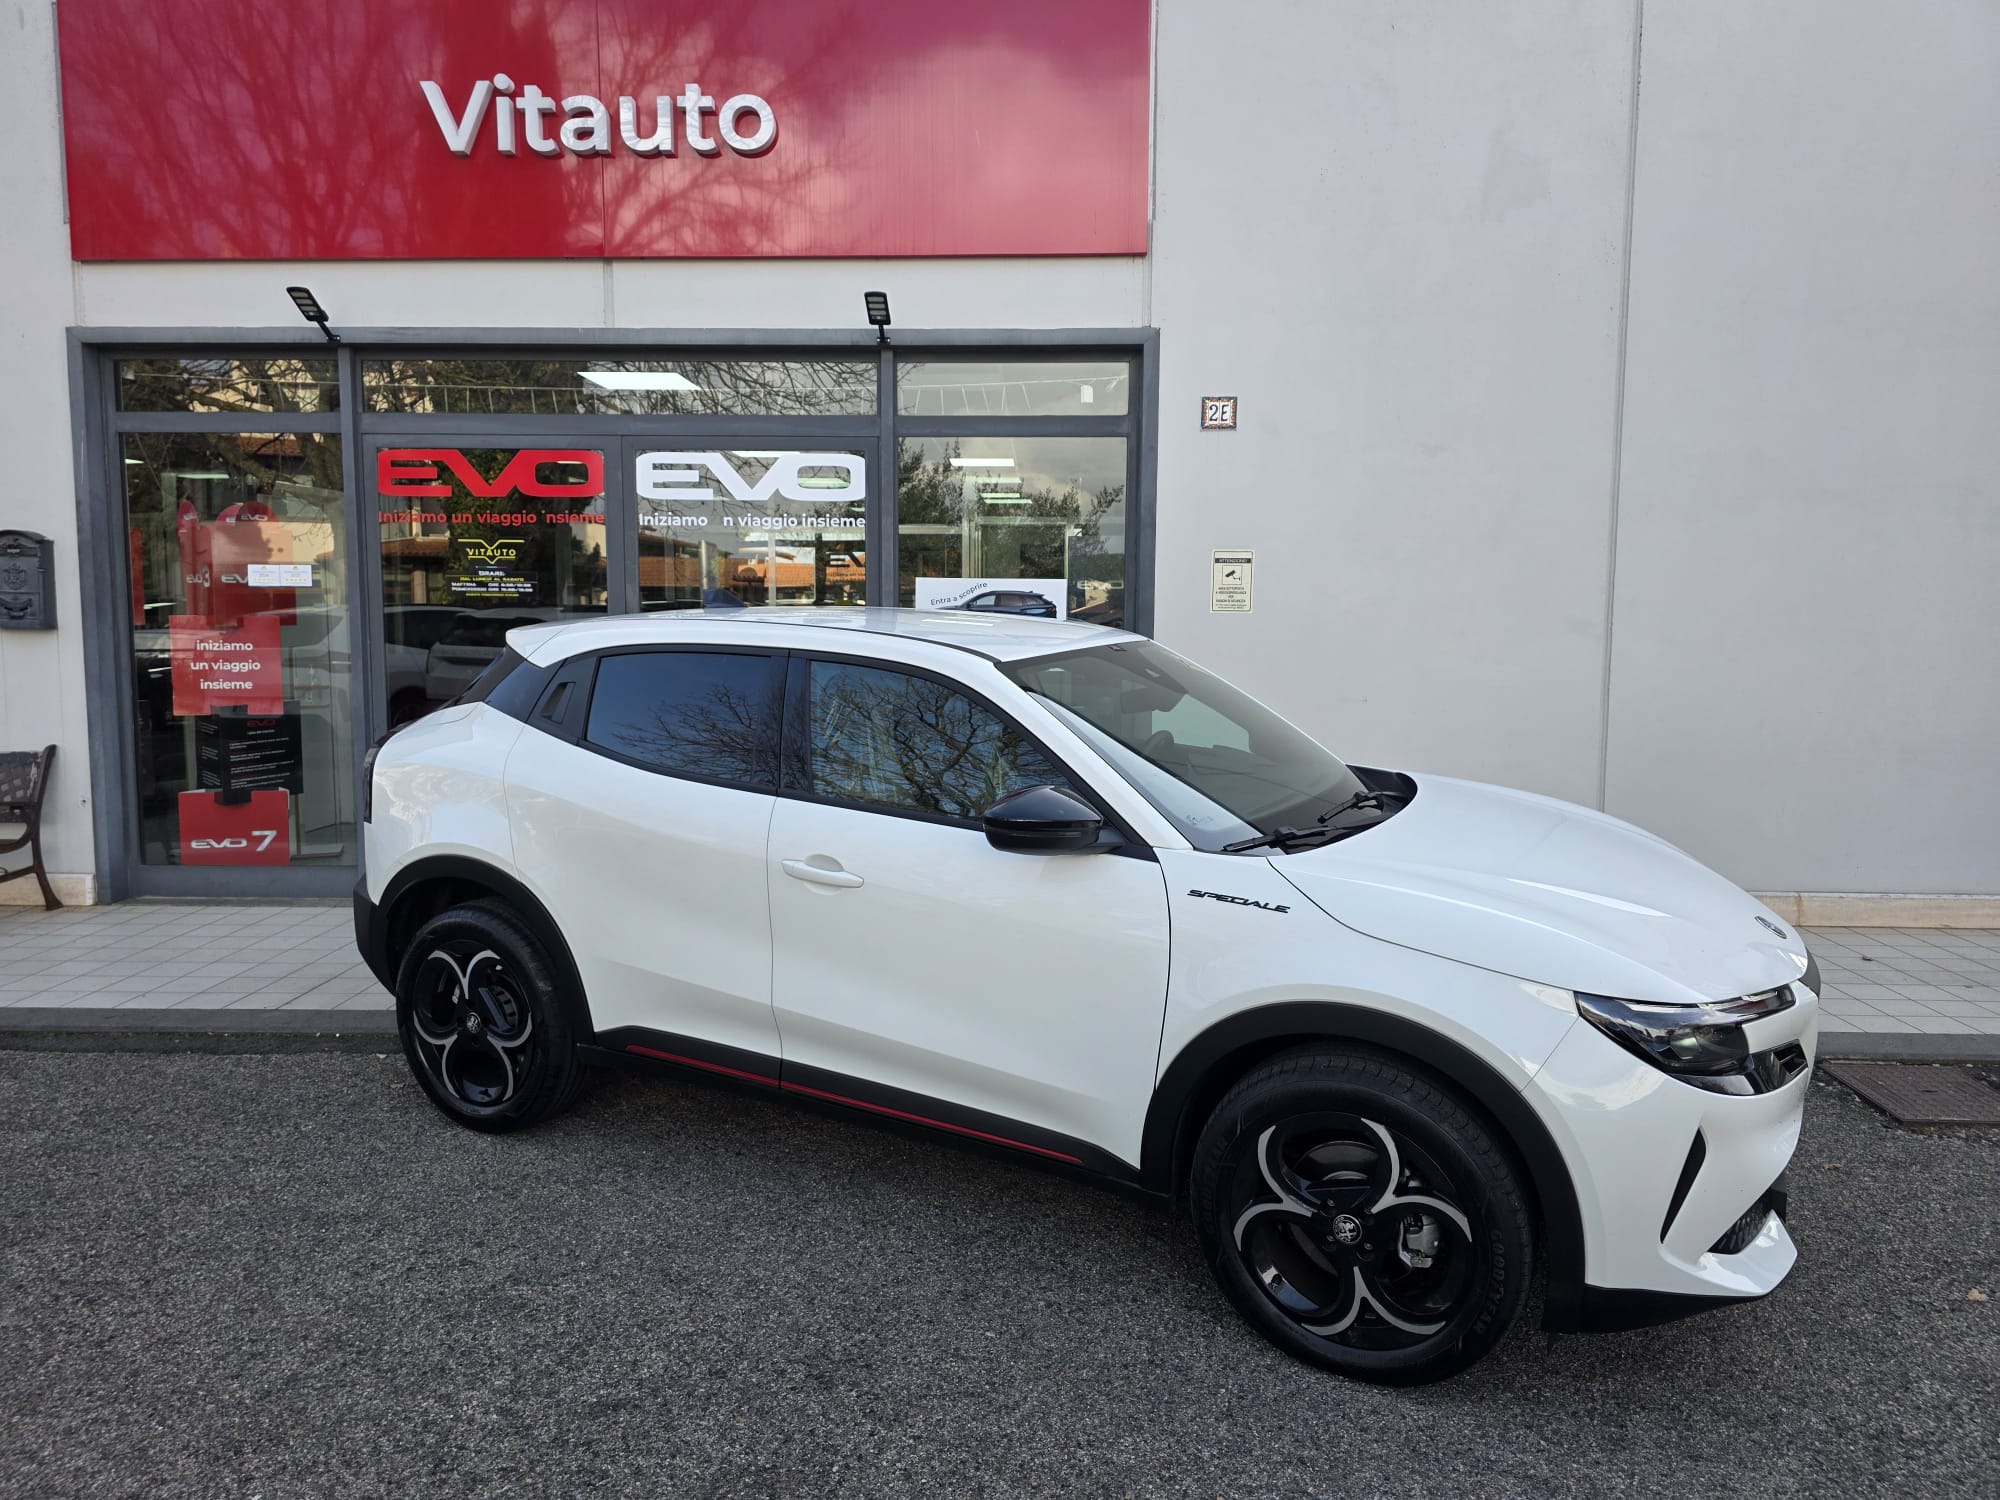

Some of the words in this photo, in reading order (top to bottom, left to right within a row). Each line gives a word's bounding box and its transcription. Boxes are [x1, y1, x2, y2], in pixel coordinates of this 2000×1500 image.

[419, 72, 777, 156] Vitauto
[1209, 404, 1229, 421] 2E
[377, 450, 604, 497] EVO
[636, 452, 866, 501] EVO
[378, 510, 447, 523] Iniziamo
[451, 513, 472, 523] un
[476, 509, 537, 526] viaggio
[541, 509, 605, 524] nsieme
[639, 512, 708, 526] Iniziamo
[738, 513, 798, 529] viaggio
[802, 513, 865, 528] insieme
[466, 548, 516, 556] VITAUTO
[221, 573, 248, 584] EV
[930, 597, 951, 605] Entra
[196, 639, 253, 651] iniziamo
[190, 662, 209, 670] un
[211, 659, 261, 673] viaggio
[200, 679, 253, 690] insieme
[251, 829, 277, 852] 7
[1187, 889, 1291, 914] SPECIALE
